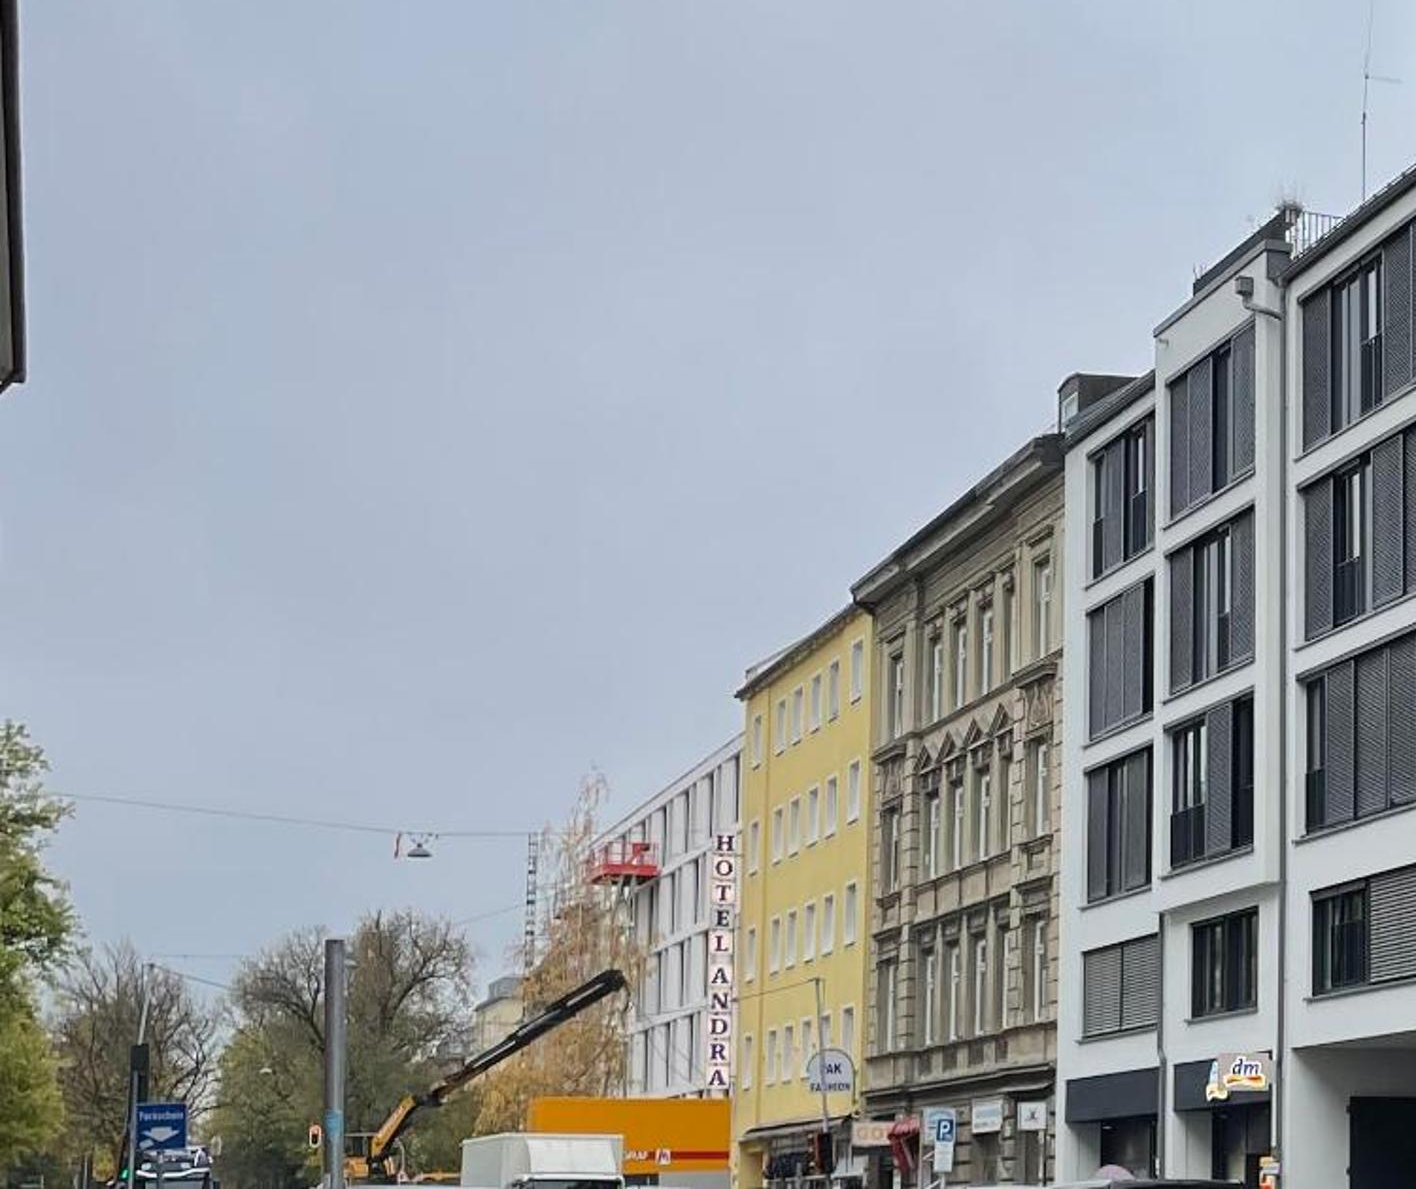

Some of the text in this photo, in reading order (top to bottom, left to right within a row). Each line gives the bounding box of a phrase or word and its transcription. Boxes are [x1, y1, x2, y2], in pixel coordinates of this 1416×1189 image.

[709, 835, 735, 1086] HOTEL ANDRA
[1231, 1057, 1260, 1076] dm
[940, 1120, 951, 1140] P
